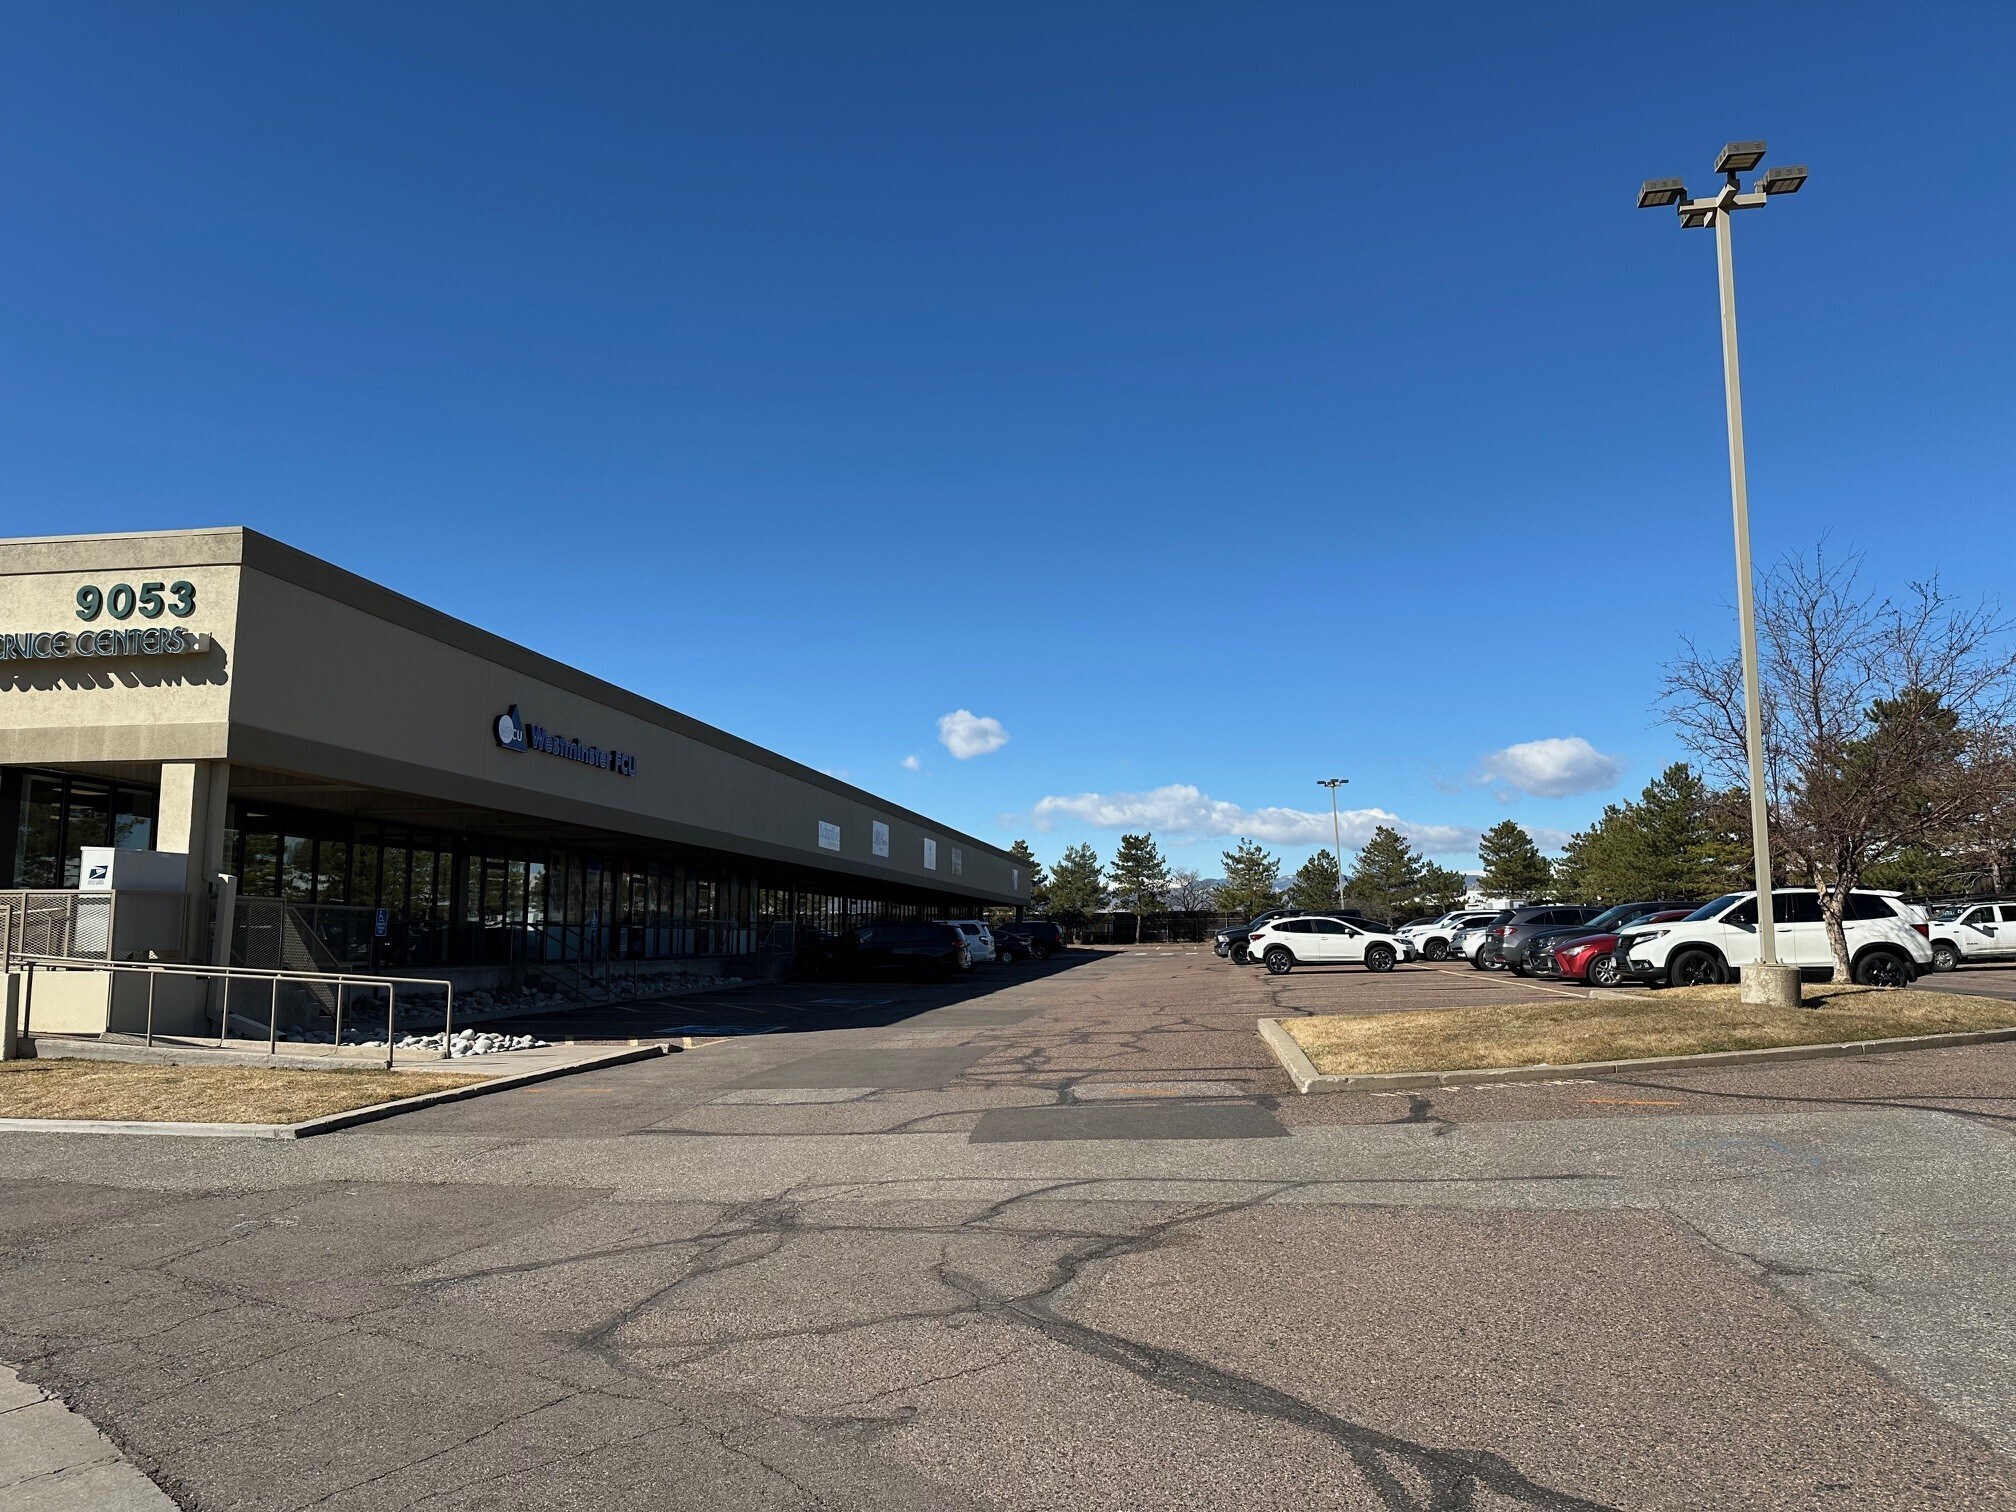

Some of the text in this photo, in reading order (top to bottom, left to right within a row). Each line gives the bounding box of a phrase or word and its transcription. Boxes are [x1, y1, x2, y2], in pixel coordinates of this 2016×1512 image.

[75, 580, 197, 622] 9053
[0, 626, 186, 660] RVICE CENTERS
[531, 724, 637, 776] Westminster FCU
